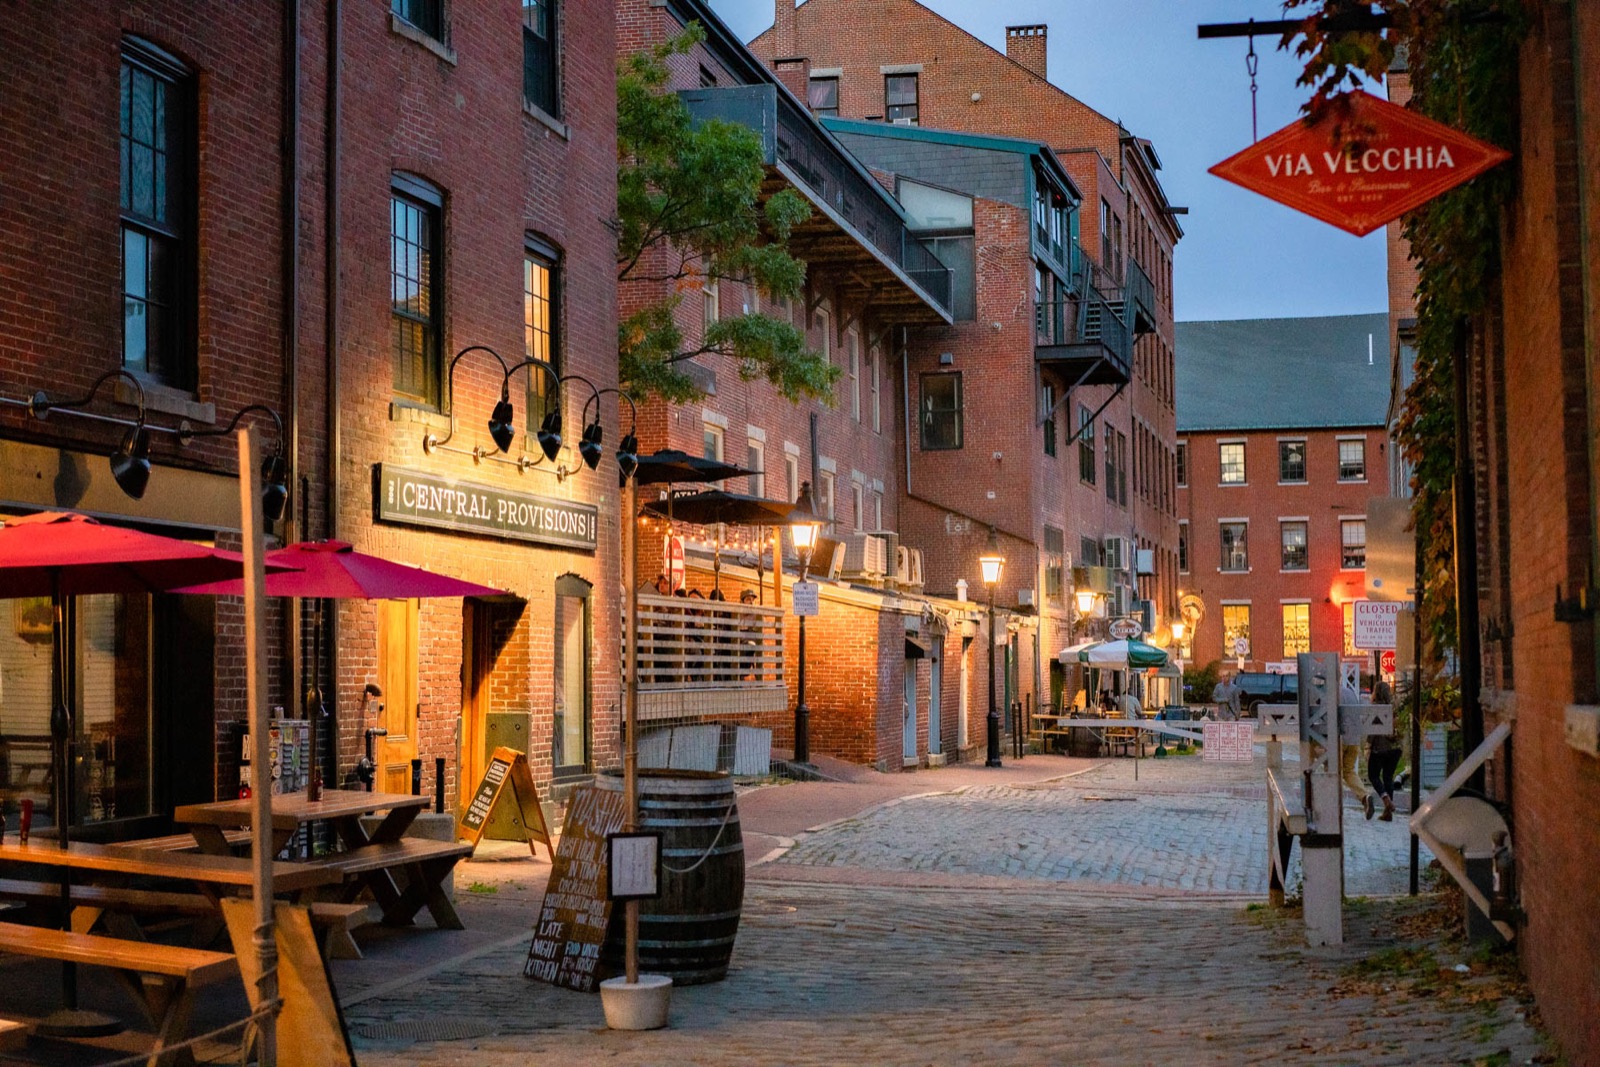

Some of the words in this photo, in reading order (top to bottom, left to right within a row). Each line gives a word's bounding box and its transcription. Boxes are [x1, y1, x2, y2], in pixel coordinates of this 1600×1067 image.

[402, 481, 491, 519] CENTRAL
[497, 498, 587, 536] PROVISIONS
[1359, 604, 1398, 614] CLOSED
[1382, 657, 1396, 667] STO
[540, 921, 564, 938] LATE
[532, 939, 561, 958] NIGHT
[581, 943, 600, 958] UNTIL
[525, 958, 560, 982] KITCHEN
